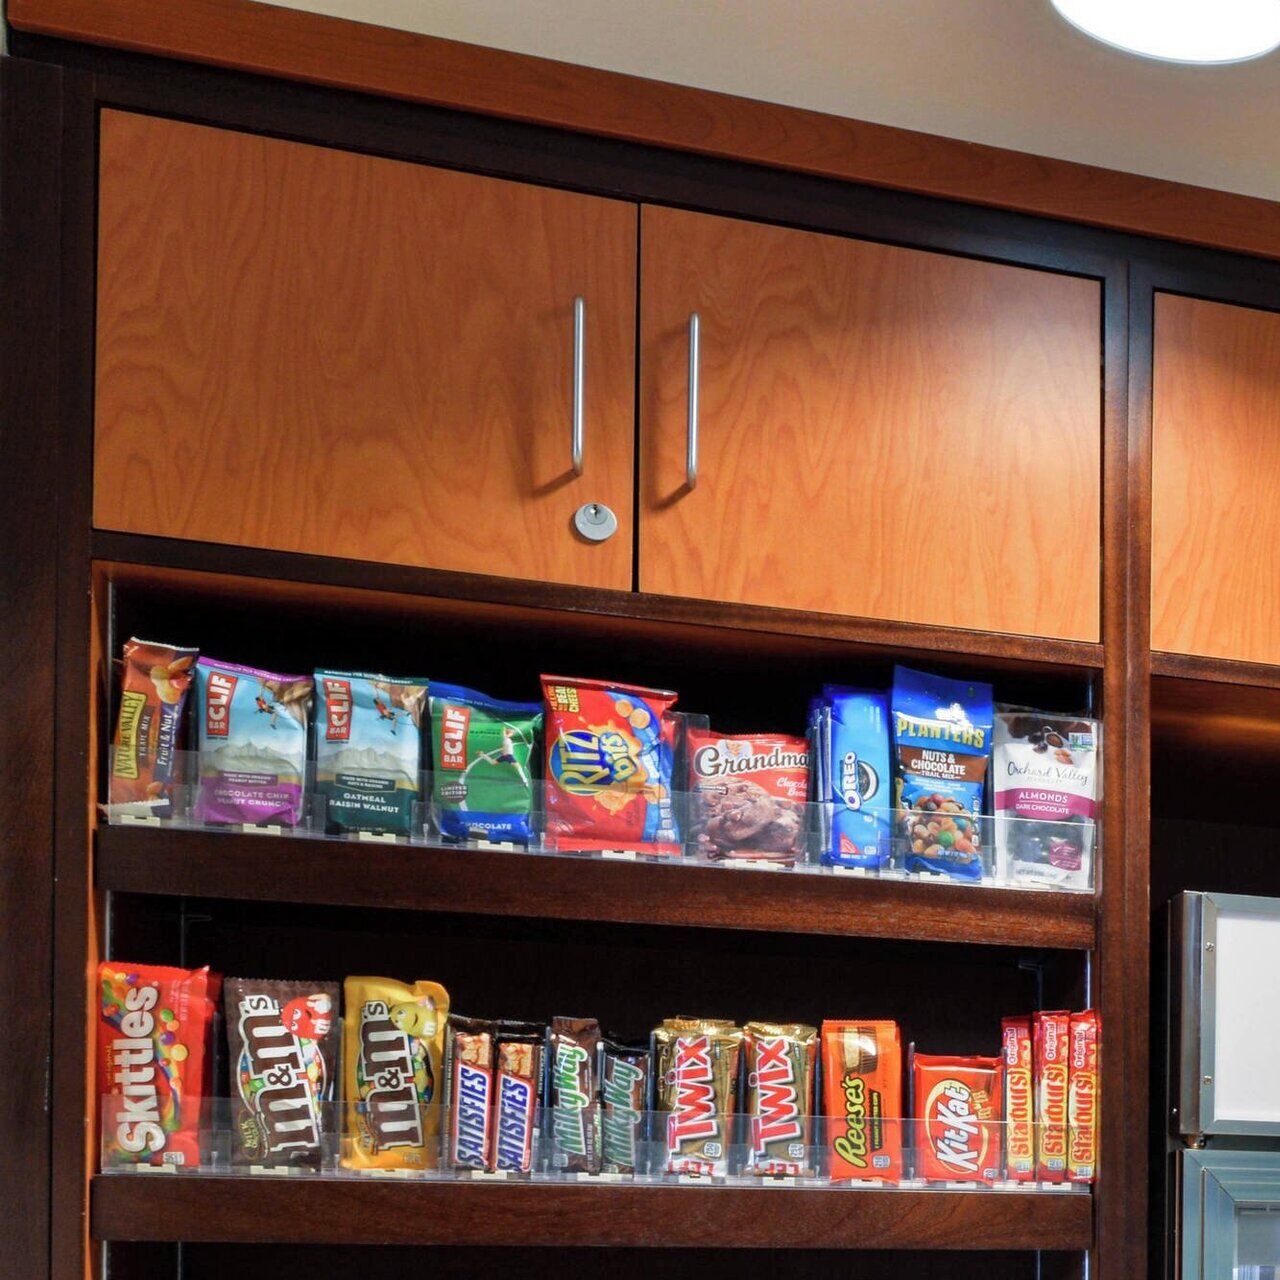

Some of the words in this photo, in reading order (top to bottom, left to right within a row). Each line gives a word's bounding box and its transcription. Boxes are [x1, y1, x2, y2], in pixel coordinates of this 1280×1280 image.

[122, 695, 141, 732] VALLEY
[209, 675, 231, 720] CLIF
[327, 681, 348, 728] CLIF
[157, 745, 168, 766] Fruit
[165, 714, 174, 730] Nut
[208, 721, 225, 730] BAR
[444, 708, 468, 755] CLIF
[116, 733, 137, 775] NATURE
[444, 755, 463, 763] BAR
[559, 735, 610, 785] RITZ
[911, 760, 966, 776] CHOCOLATE
[922, 750, 946, 762] NUTS
[947, 753, 955, 763] &
[841, 751, 861, 810] OREO
[921, 770, 940, 778] TRAIL
[1008, 761, 1051, 776] Orchard
[1056, 767, 1089, 786] Valley
[344, 793, 386, 803] OATMEAL
[363, 804, 399, 813] WALNUT
[1015, 803, 1035, 811] DARK
[1036, 805, 1070, 814] CHOCOLATE
[1018, 792, 1068, 803] ALMONDS
[1007, 1027, 1017, 1065] Original
[1045, 1022, 1056, 1060] Original
[1074, 1030, 1084, 1068] Original
[116, 985, 166, 1153] Skittles
[454, 1067, 487, 1169] SATISFIES
[497, 1078, 529, 1172] SATISFIES
